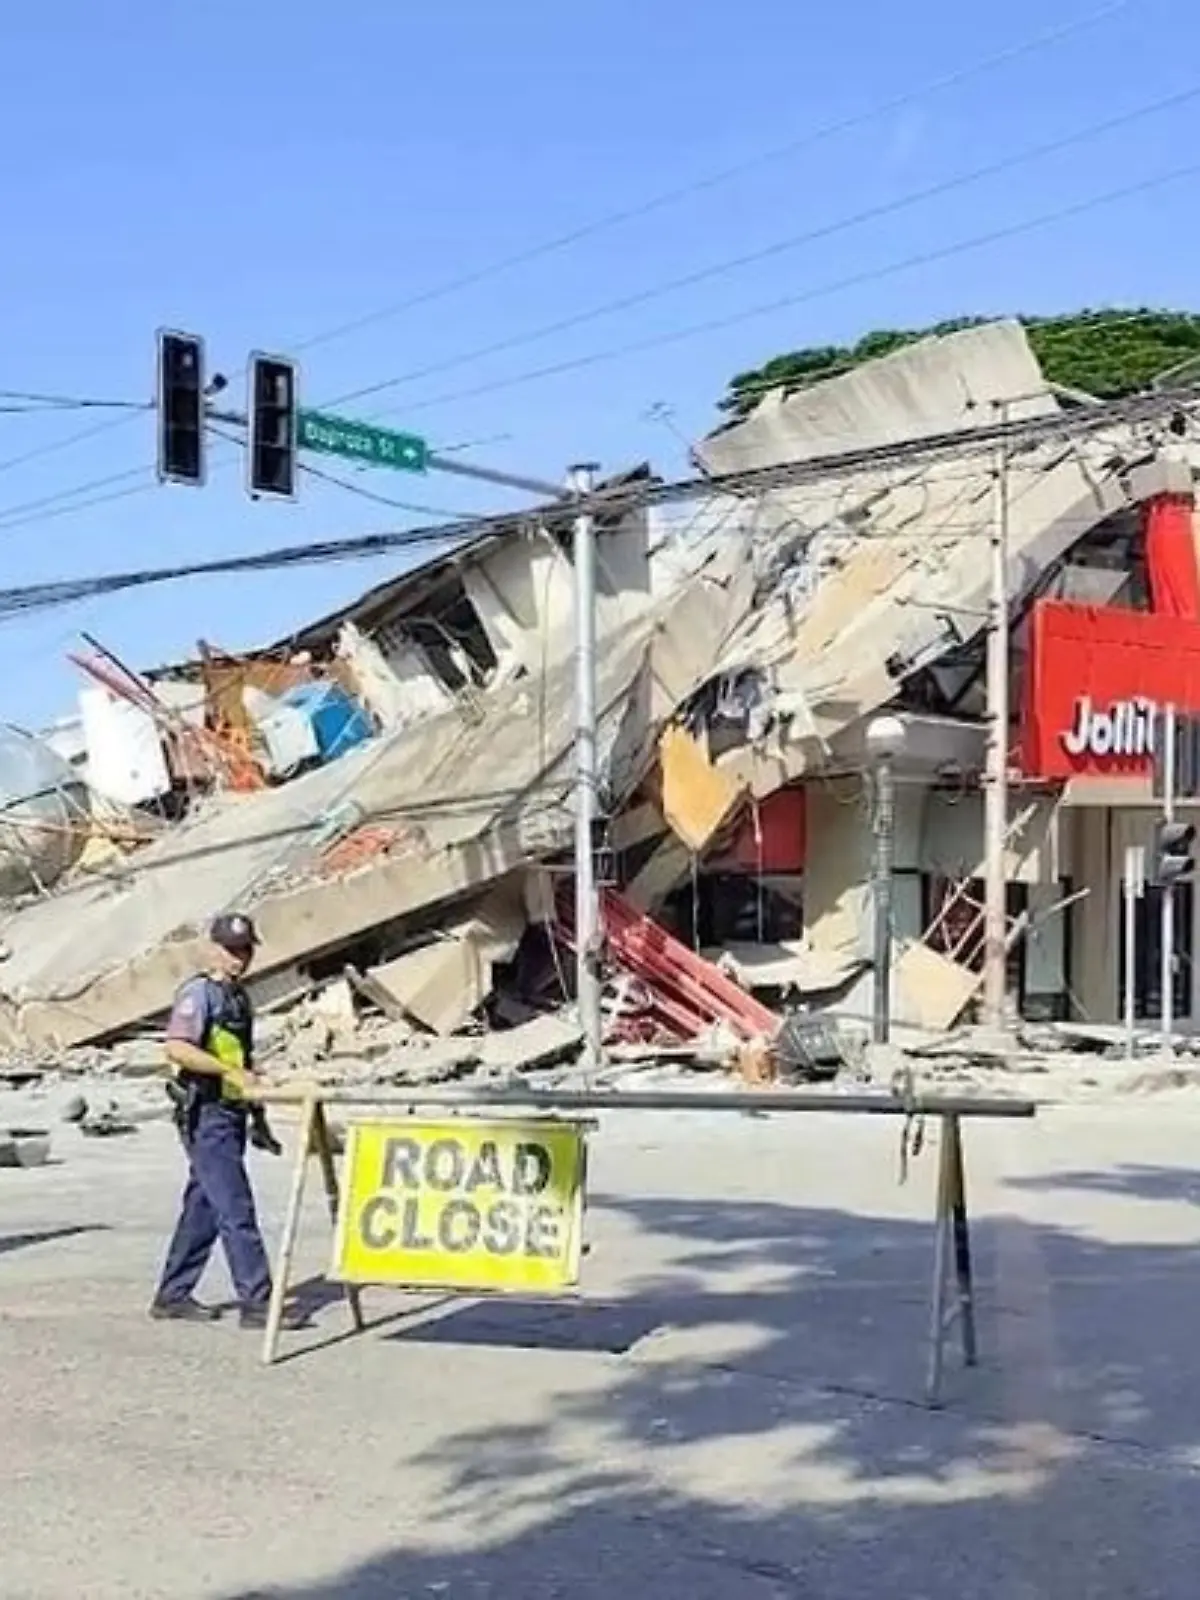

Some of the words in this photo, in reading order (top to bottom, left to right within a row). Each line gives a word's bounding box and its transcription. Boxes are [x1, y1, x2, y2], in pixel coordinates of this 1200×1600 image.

[1058, 696, 1155, 754] Jolli
[382, 1137, 552, 1195] ROAD
[359, 1196, 562, 1258] CLOSE
